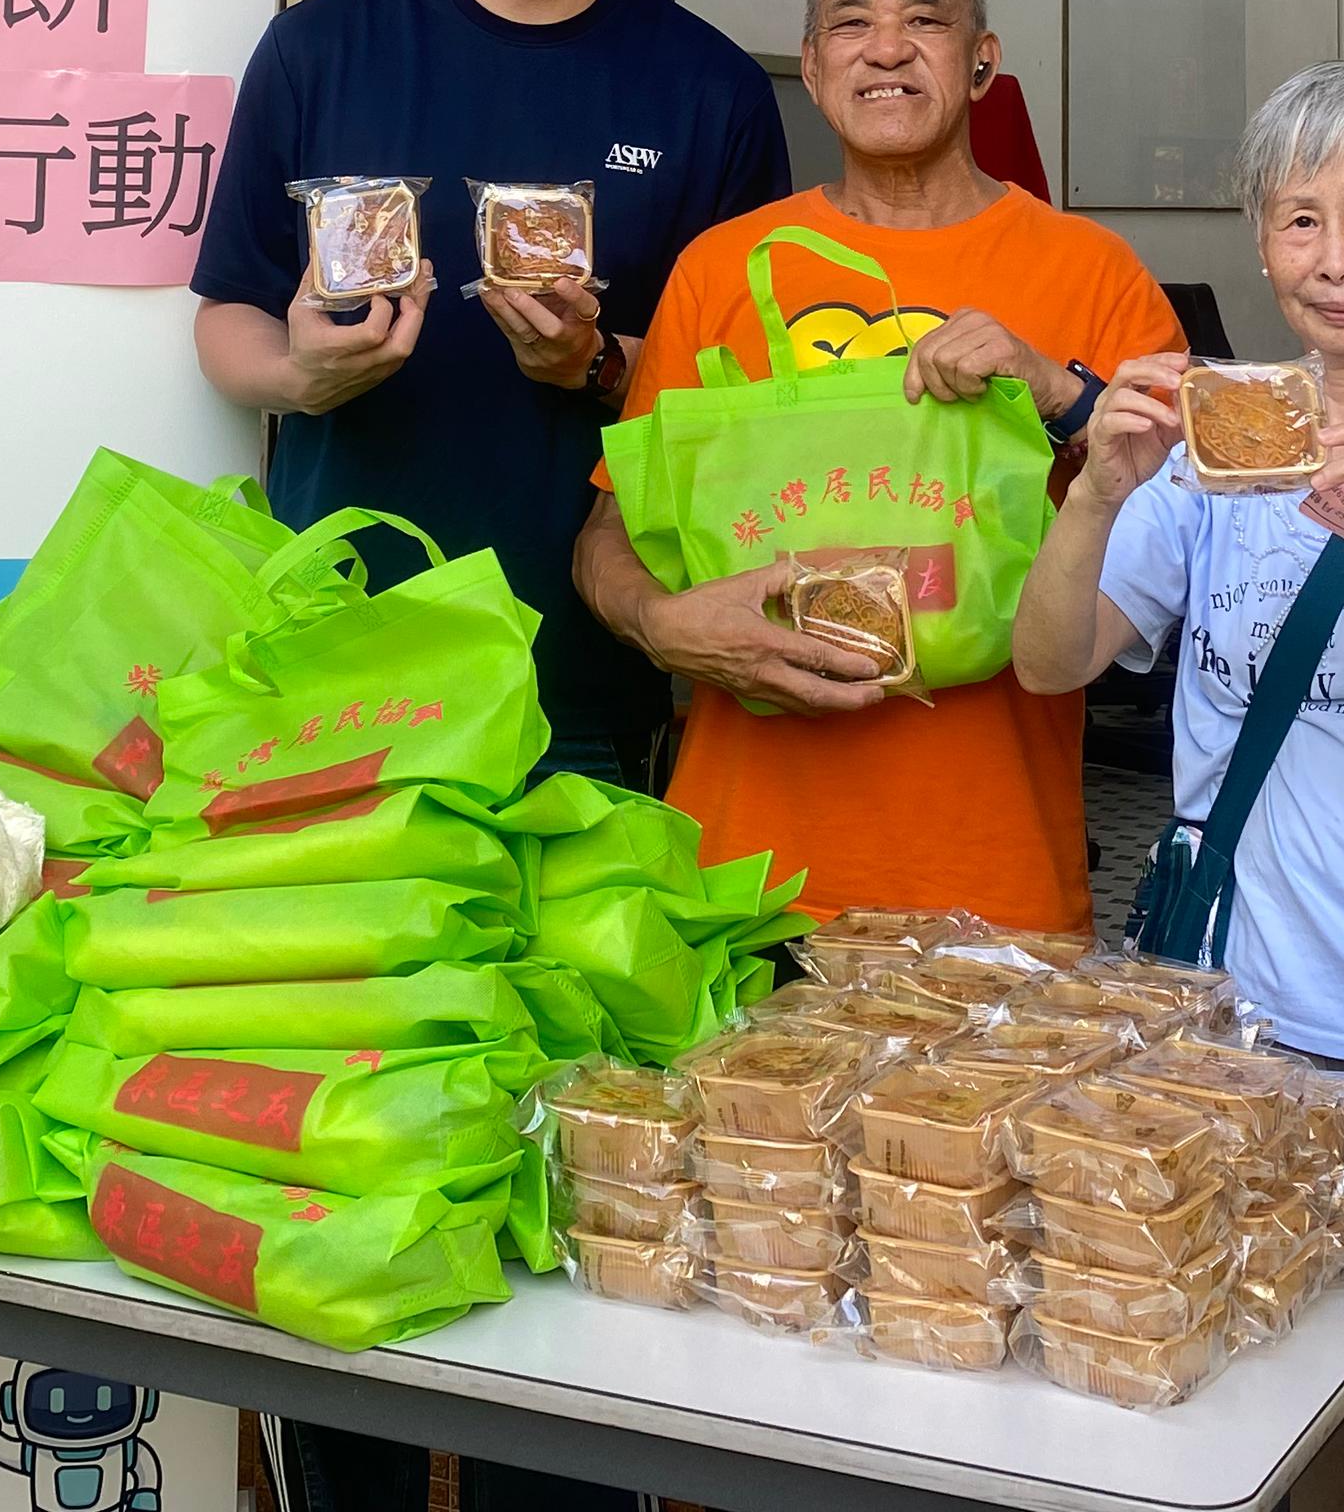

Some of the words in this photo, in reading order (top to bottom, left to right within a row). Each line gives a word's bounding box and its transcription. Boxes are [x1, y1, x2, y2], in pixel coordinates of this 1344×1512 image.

[605, 143, 663, 169] ASPW
[1209, 581, 1250, 613] njoy
[1258, 578, 1302, 602] you
[130, 1063, 296, 1138] 東區之友
[102, 1183, 253, 1297] 東區之友
